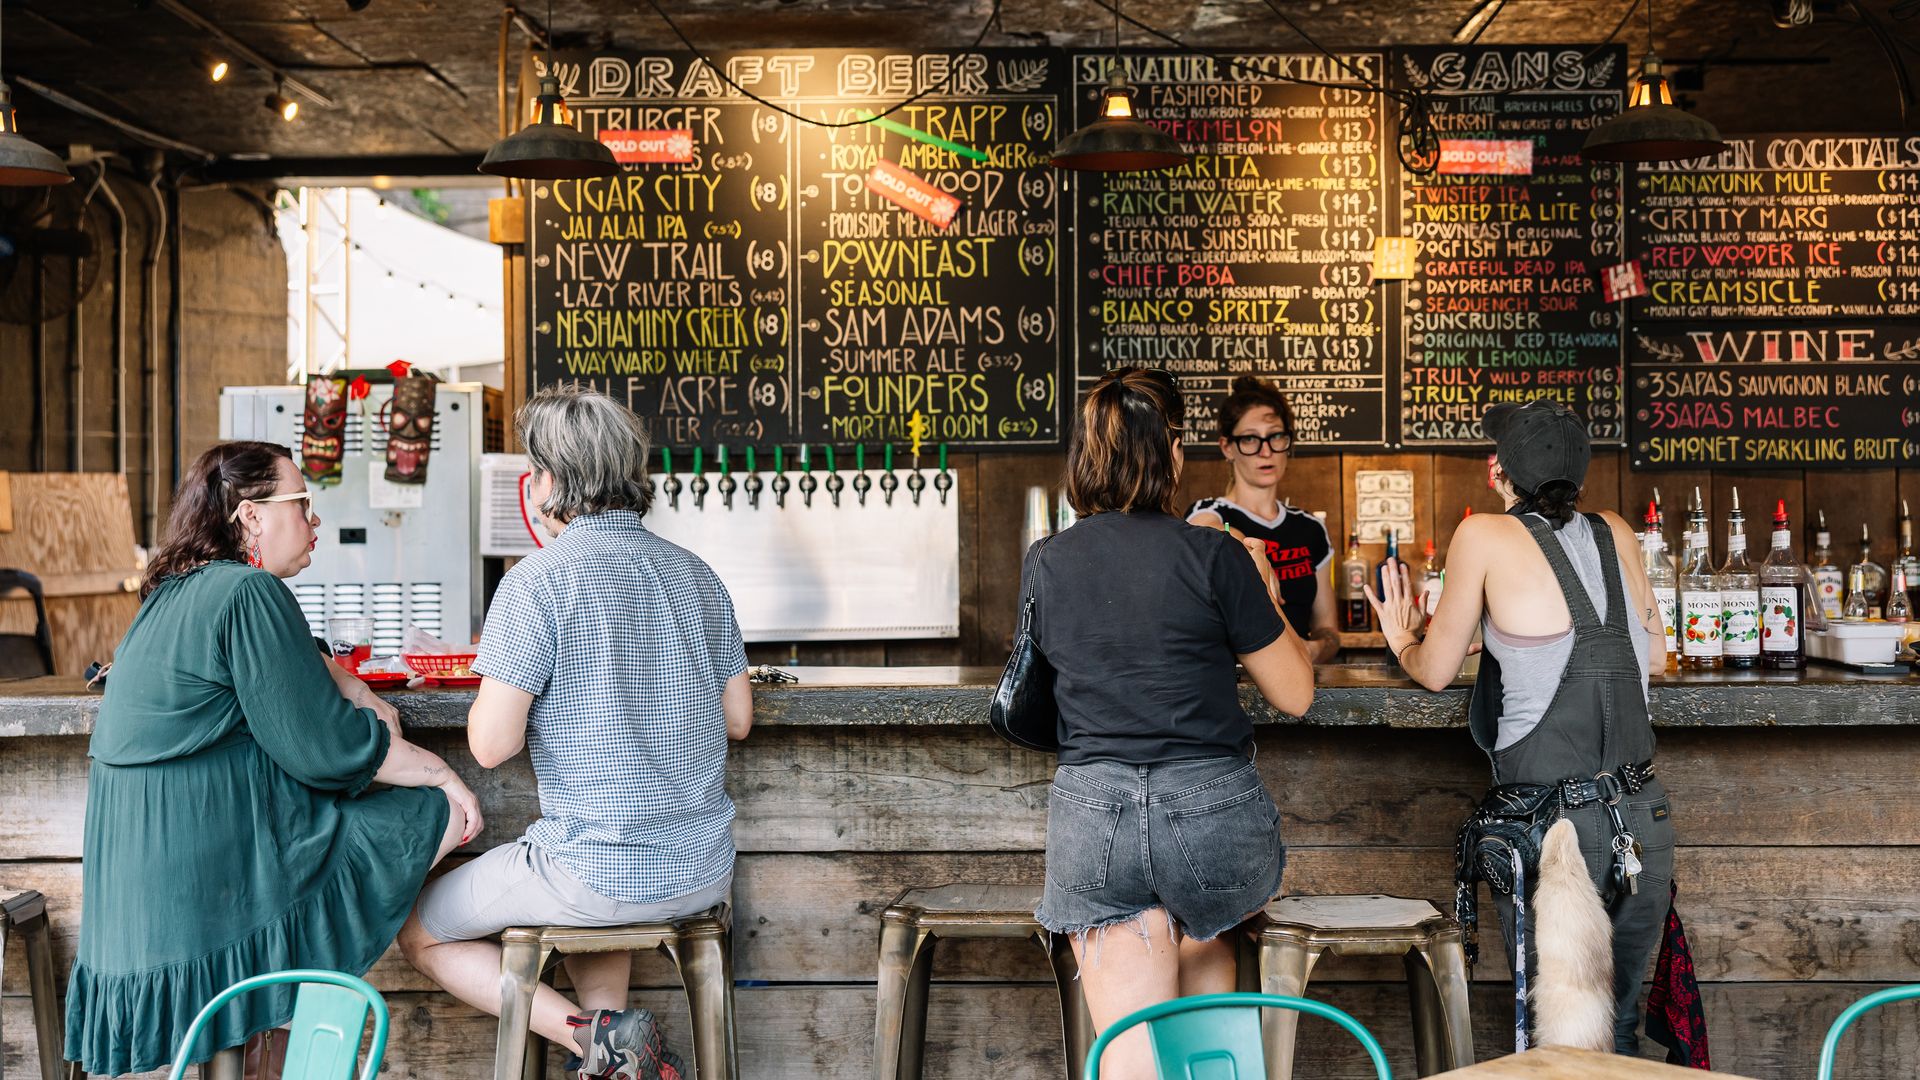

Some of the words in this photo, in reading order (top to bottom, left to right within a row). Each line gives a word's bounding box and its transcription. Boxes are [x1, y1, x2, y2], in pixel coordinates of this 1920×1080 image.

[589, 56, 815, 98] DRAFT
[837, 54, 989, 96] BEER
[1082, 56, 1222, 83] SINATURE
[1230, 56, 1373, 83] COCKTAILS
[1430, 51, 1586, 91] CANS
[1151, 85, 1263, 106] FASHIONED
[567, 107, 723, 145] ITBURGER
[902, 105, 1008, 143] TRAPP
[639, 140, 666, 152] OUT
[899, 144, 961, 169] AMBER
[972, 143, 1028, 169] LAGER
[1297, 142, 1338, 155] GINGER
[1341, 141, 1373, 154] BEER
[1441, 151, 1477, 163] SOLD
[1478, 151, 1505, 163] OUT
[553, 175, 645, 213] CIGAR
[654, 174, 723, 212] CITY
[873, 168, 907, 194] SOLD
[905, 186, 933, 207] OUT
[1109, 178, 1161, 192] LUNAZUL
[1169, 178, 1215, 192] BLANCO
[1219, 178, 1271, 191] TEQUILA
[1650, 173, 1764, 193] MANAYUNK
[1775, 172, 1832, 193] MULE
[1103, 192, 1185, 215] RANCH
[1194, 191, 1284, 214] WATER
[1414, 186, 1492, 203] TWISTED
[1498, 186, 1531, 201] TEA
[1108, 215, 1158, 228] TEQUILA
[1163, 215, 1199, 228] OCHO
[1208, 215, 1242, 228] CLUB
[1247, 213, 1281, 227] SODA
[1291, 213, 1328, 227] FRESH
[1334, 214, 1368, 228] LIME
[1413, 204, 1492, 221] TWISTED
[1497, 203, 1531, 220] TEA
[1539, 203, 1582, 220] LITE
[1649, 208, 1748, 230] GRITTY
[1760, 206, 1828, 229] MARG
[561, 214, 593, 241] JAI
[600, 214, 646, 240] ALAI
[657, 214, 688, 239] IPA
[830, 211, 891, 239] POOLSIDE
[967, 210, 1019, 237] LAGER
[1413, 221, 1512, 240] DOWNEAST
[1516, 225, 1582, 239] ORIGINAL
[1864, 229, 1897, 242] BLACK
[1103, 229, 1195, 251] ETERNAL
[1201, 228, 1300, 251] SUNSHINE
[1506, 238, 1554, 257] HEAD
[556, 242, 632, 281] NEW
[642, 242, 736, 280] TRAIL
[823, 238, 996, 278] DOWNEAST
[1107, 251, 1163, 264] BLUECOAT
[1652, 246, 1697, 267] RED
[1701, 243, 1796, 267] WOODER
[1808, 242, 1842, 265] ICE
[1102, 265, 1168, 286] CHIEF
[1178, 264, 1235, 286] BOBA
[1425, 261, 1508, 276] GRATEFUL
[1514, 260, 1556, 276] DEAD
[1564, 260, 1586, 274] IPA
[1648, 269, 1687, 280] MOUNT
[1691, 268, 1713, 280] GAY
[1714, 268, 1738, 280] RUM
[1804, 265, 1841, 279] PUNCH
[1850, 265, 1892, 278] PASSION
[562, 282, 618, 308] LAZY
[627, 282, 692, 307] RIVER
[700, 281, 742, 307] PILS
[830, 280, 950, 306] SEASONAL
[1106, 286, 1151, 299] MOUNT
[1155, 286, 1179, 299] GAY
[1185, 286, 1214, 299] RUM
[1221, 285, 1267, 299] PASSION
[1269, 285, 1302, 298] FRUIT
[1312, 286, 1345, 299] BOBA
[1347, 287, 1370, 299] POP
[1426, 278, 1533, 295] DAYDREAMER
[1539, 277, 1595, 294] LAGER
[1651, 279, 1821, 304] CREAMSICLE
[1102, 300, 1194, 323] BIANCO
[1208, 300, 1290, 323] SPRITZ
[1425, 297, 1529, 314] SEAQUENCH
[1539, 296, 1579, 312] SOUR
[1649, 306, 1686, 317] MOUNT
[556, 309, 683, 348] NESHAMINY
[686, 307, 749, 347] CREEK
[823, 307, 887, 347] SAM
[900, 306, 1005, 346] ADAMS
[1107, 323, 1157, 336] CARPANO
[1160, 323, 1198, 336] BIANCO
[1206, 323, 1275, 336] GRAPEFRUIT
[1283, 322, 1340, 336] SPARKLING
[1413, 311, 1541, 331] SUNCRUISER
[1102, 336, 1201, 360] KENTUCKY
[1211, 336, 1268, 359] PEACH
[1280, 336, 1318, 359] TEA
[1423, 333, 1506, 349] ORIGINAL
[1515, 332, 1545, 348] ICED
[1550, 332, 1576, 348] TEA
[1580, 331, 1618, 348] VODKA
[1686, 329, 1875, 364] WINE
[564, 350, 667, 375] WAYWARD
[673, 349, 743, 375] WHEAT
[829, 348, 917, 374] SUMMER
[926, 348, 967, 373] ALE
[1165, 359, 1219, 372] BOURBON
[1228, 359, 1252, 372] SUN
[1255, 359, 1278, 371] TEA
[1287, 359, 1316, 372] RIPE
[1322, 359, 1361, 372] PEACH
[1424, 350, 1469, 367] PINK
[1478, 349, 1577, 367] LEMONADE
[1411, 368, 1483, 385] TRULY
[1490, 371, 1532, 385] WILD
[1537, 369, 1586, 384] BERRY
[1738, 373, 1828, 398] SAUVIGNON
[1834, 373, 1891, 397] BLANC
[659, 376, 739, 416] ACRE
[823, 374, 990, 416] FOUNDERS
[1411, 385, 1483, 403] TRULY
[1489, 386, 1576, 402] PINEAPPLE
[832, 415, 906, 441] MORTAL
[1743, 406, 1840, 430] MALBEC
[1297, 430, 1333, 441] CHILI
[1649, 435, 1741, 463] SIMONET
[1744, 437, 1847, 463] SPARKLING
[1854, 437, 1900, 461] BRUT
[1261, 539, 1311, 562] Pizza
[1688, 601, 1720, 609] MONIN
